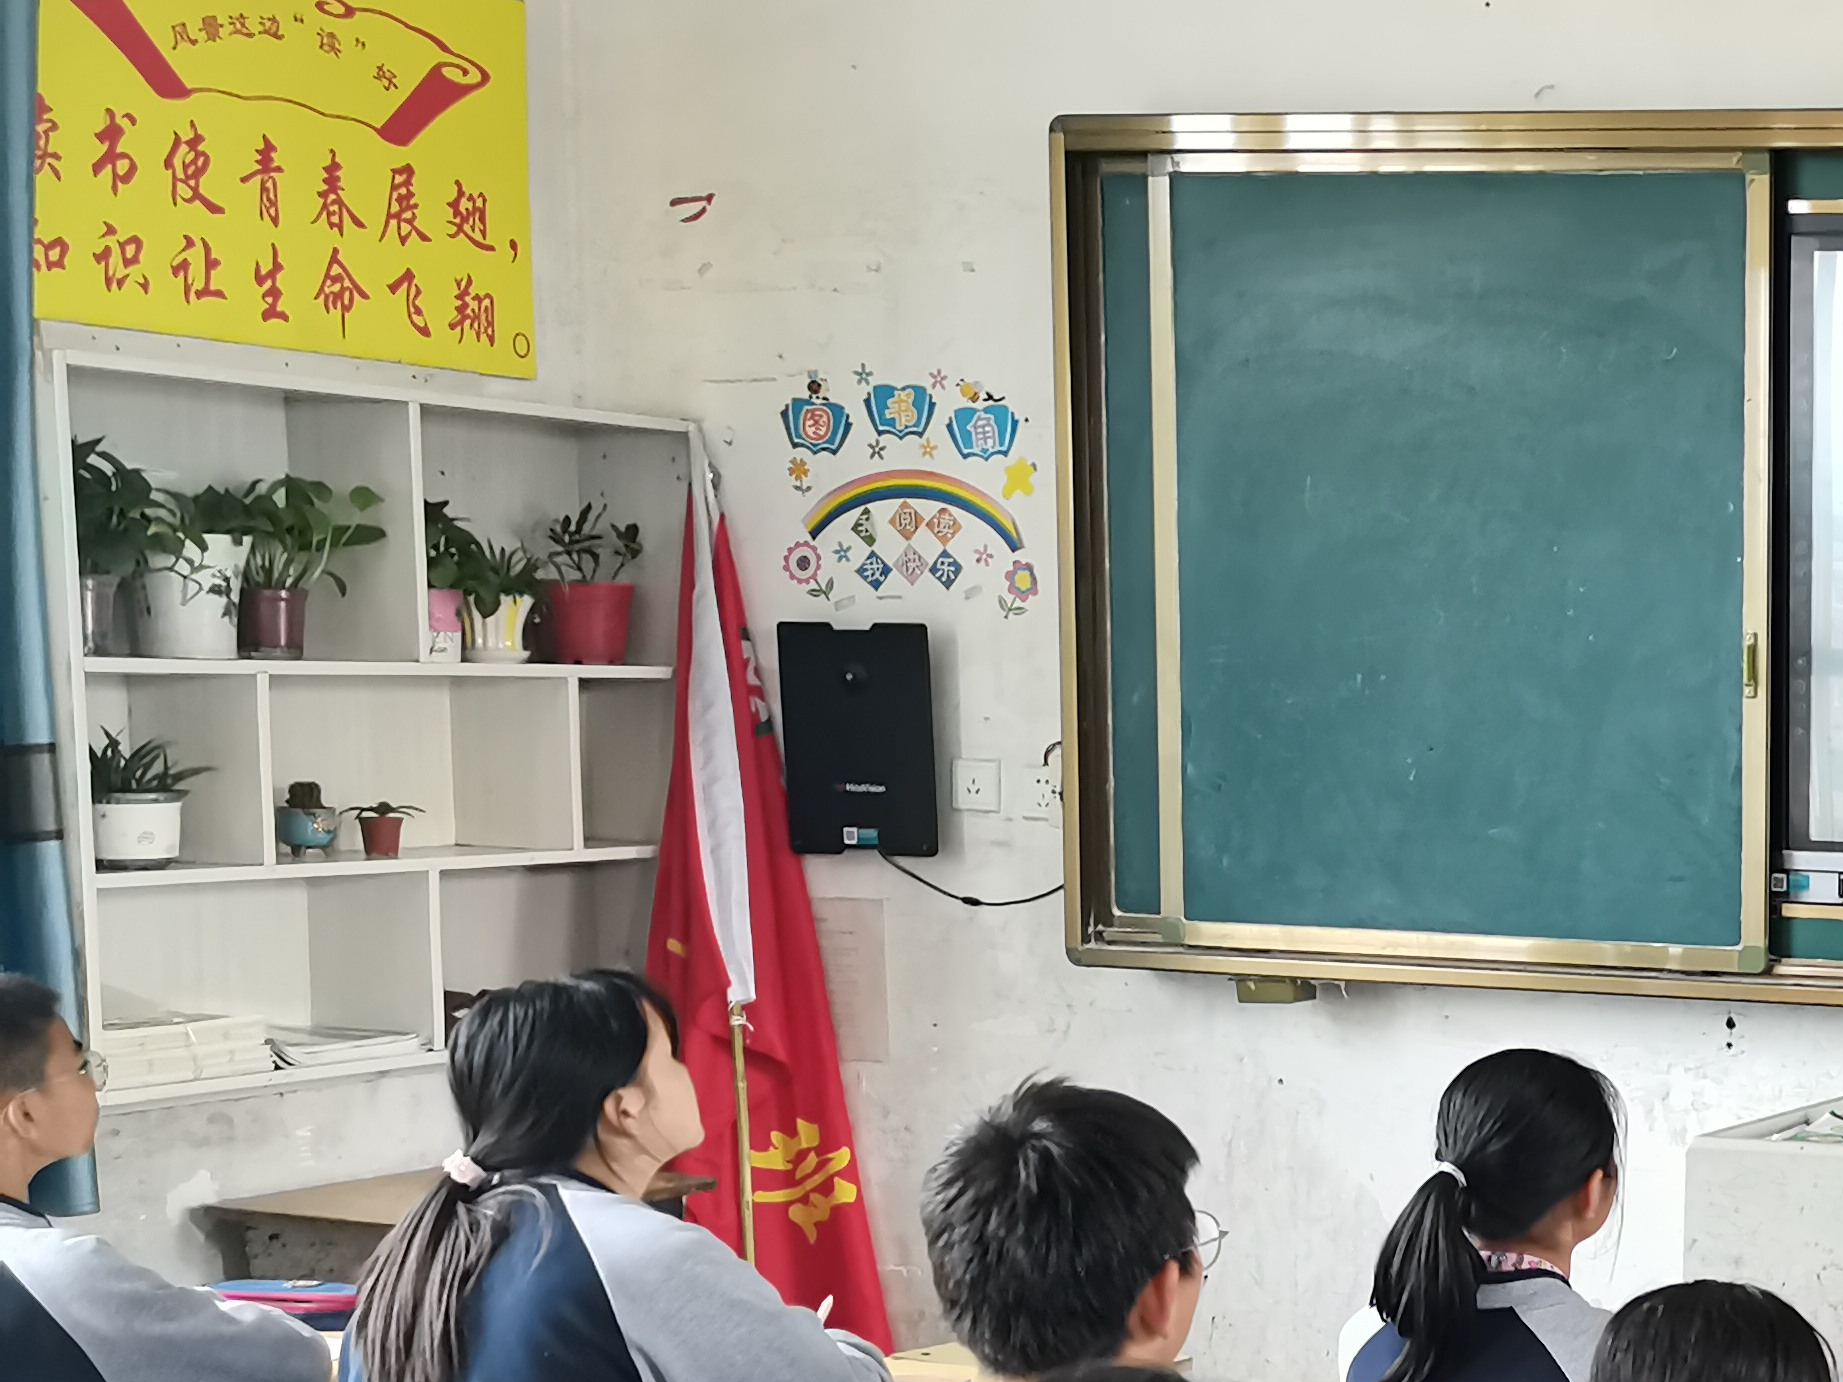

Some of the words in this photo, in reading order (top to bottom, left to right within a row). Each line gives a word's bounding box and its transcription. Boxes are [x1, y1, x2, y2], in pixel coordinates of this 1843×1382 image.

[801, 388, 998, 450] 图书角
[863, 556, 956, 583] 我快乐
